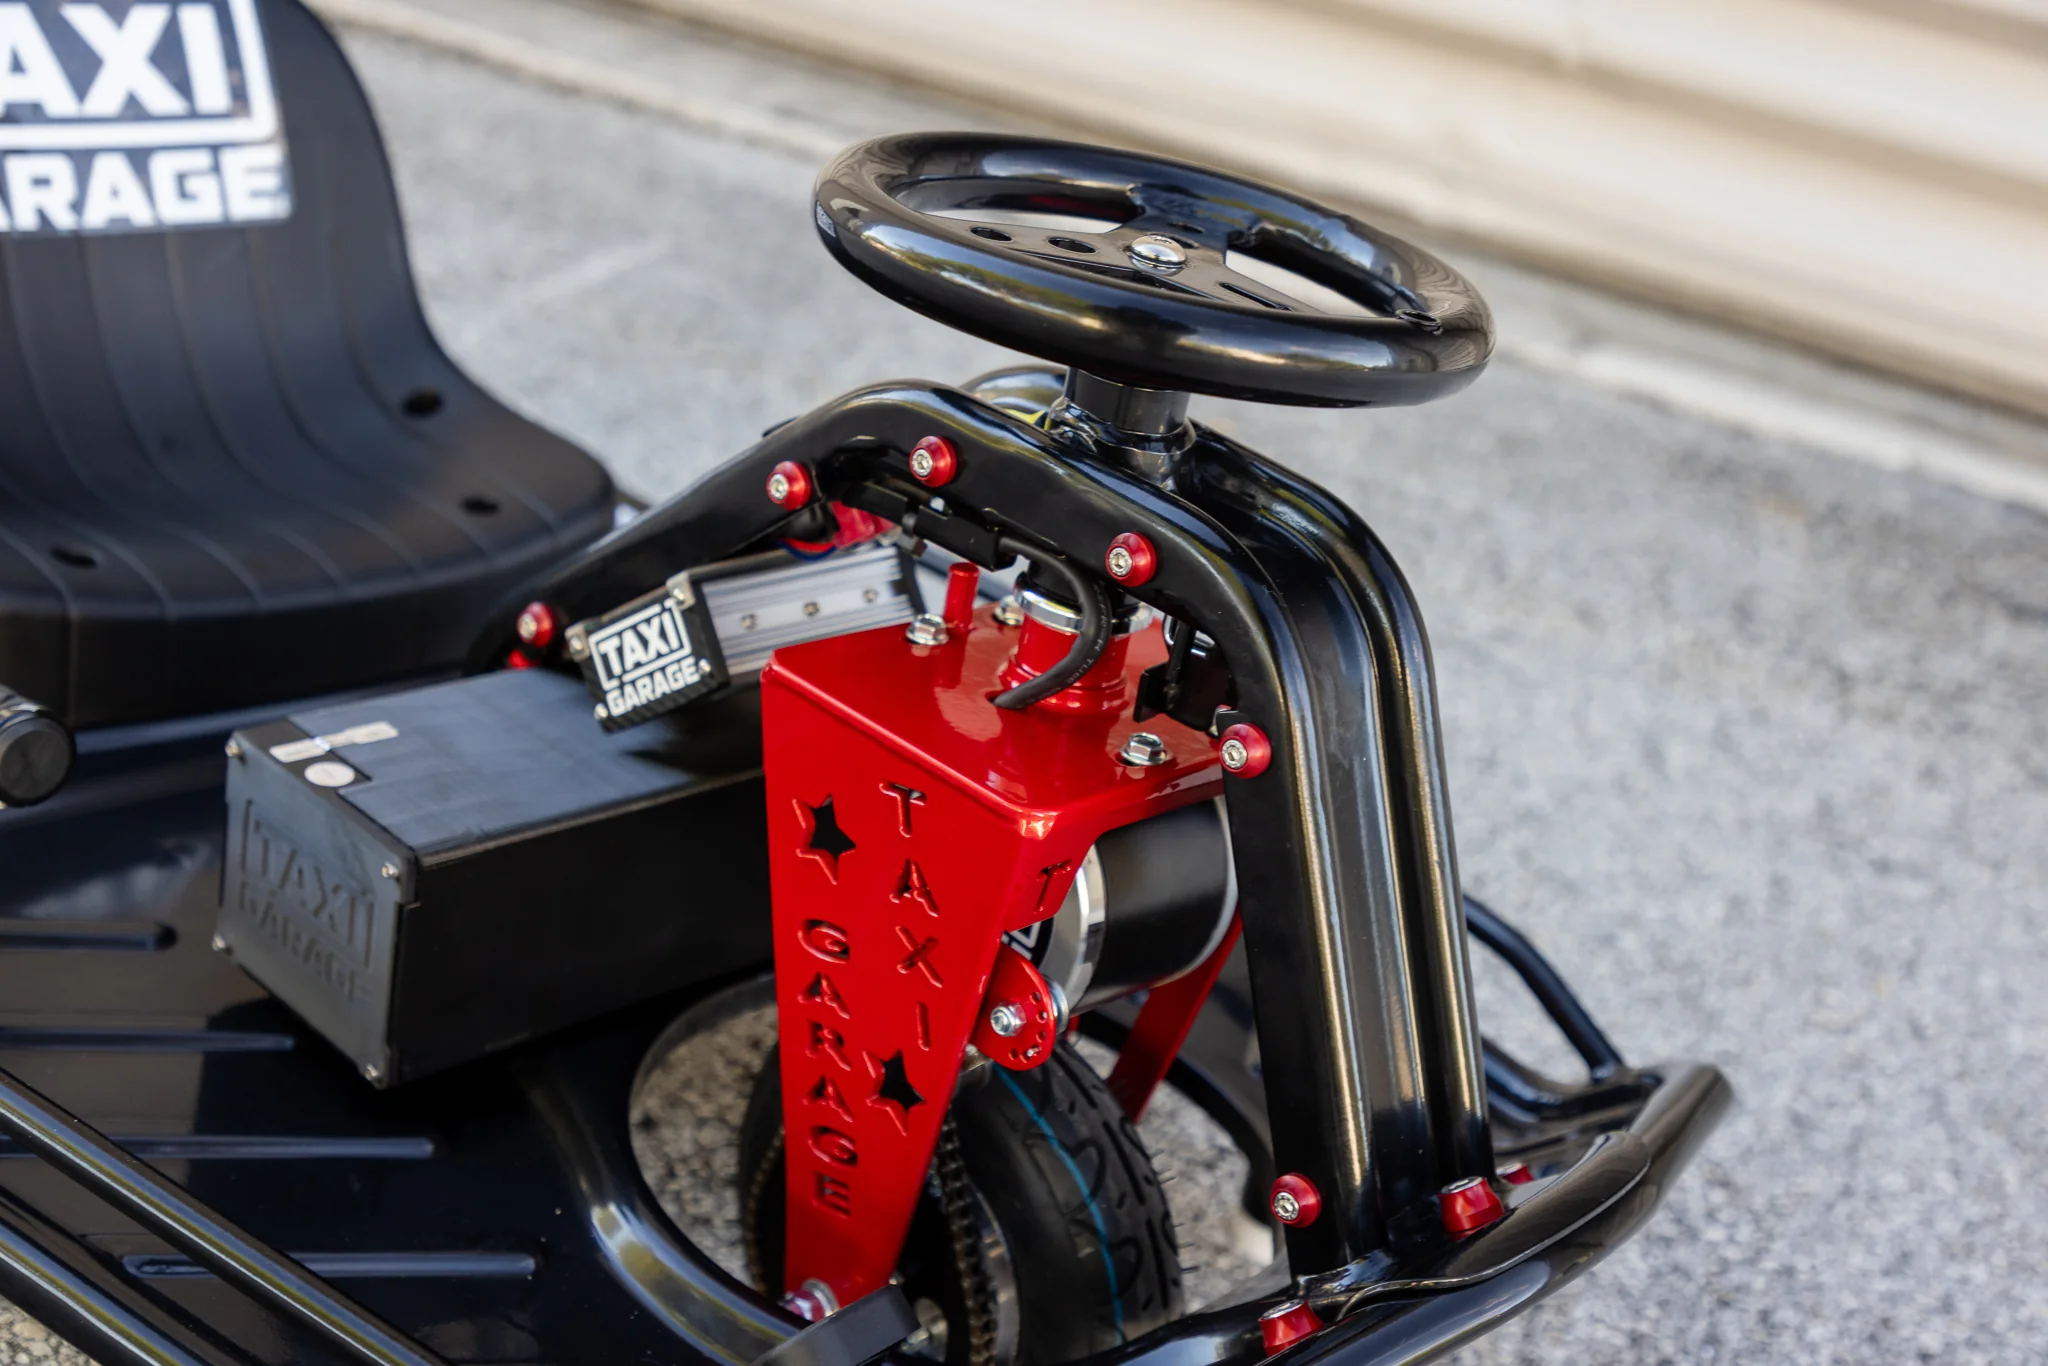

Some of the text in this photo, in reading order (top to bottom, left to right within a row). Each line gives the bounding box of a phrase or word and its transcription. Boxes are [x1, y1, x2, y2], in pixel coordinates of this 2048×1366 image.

[0, 142, 292, 232] RAGE
[597, 610, 681, 677] TAXI
[605, 655, 701, 717] GARAGE
[878, 778, 943, 1051] TAXI
[797, 918, 859, 1220] GARAGE
